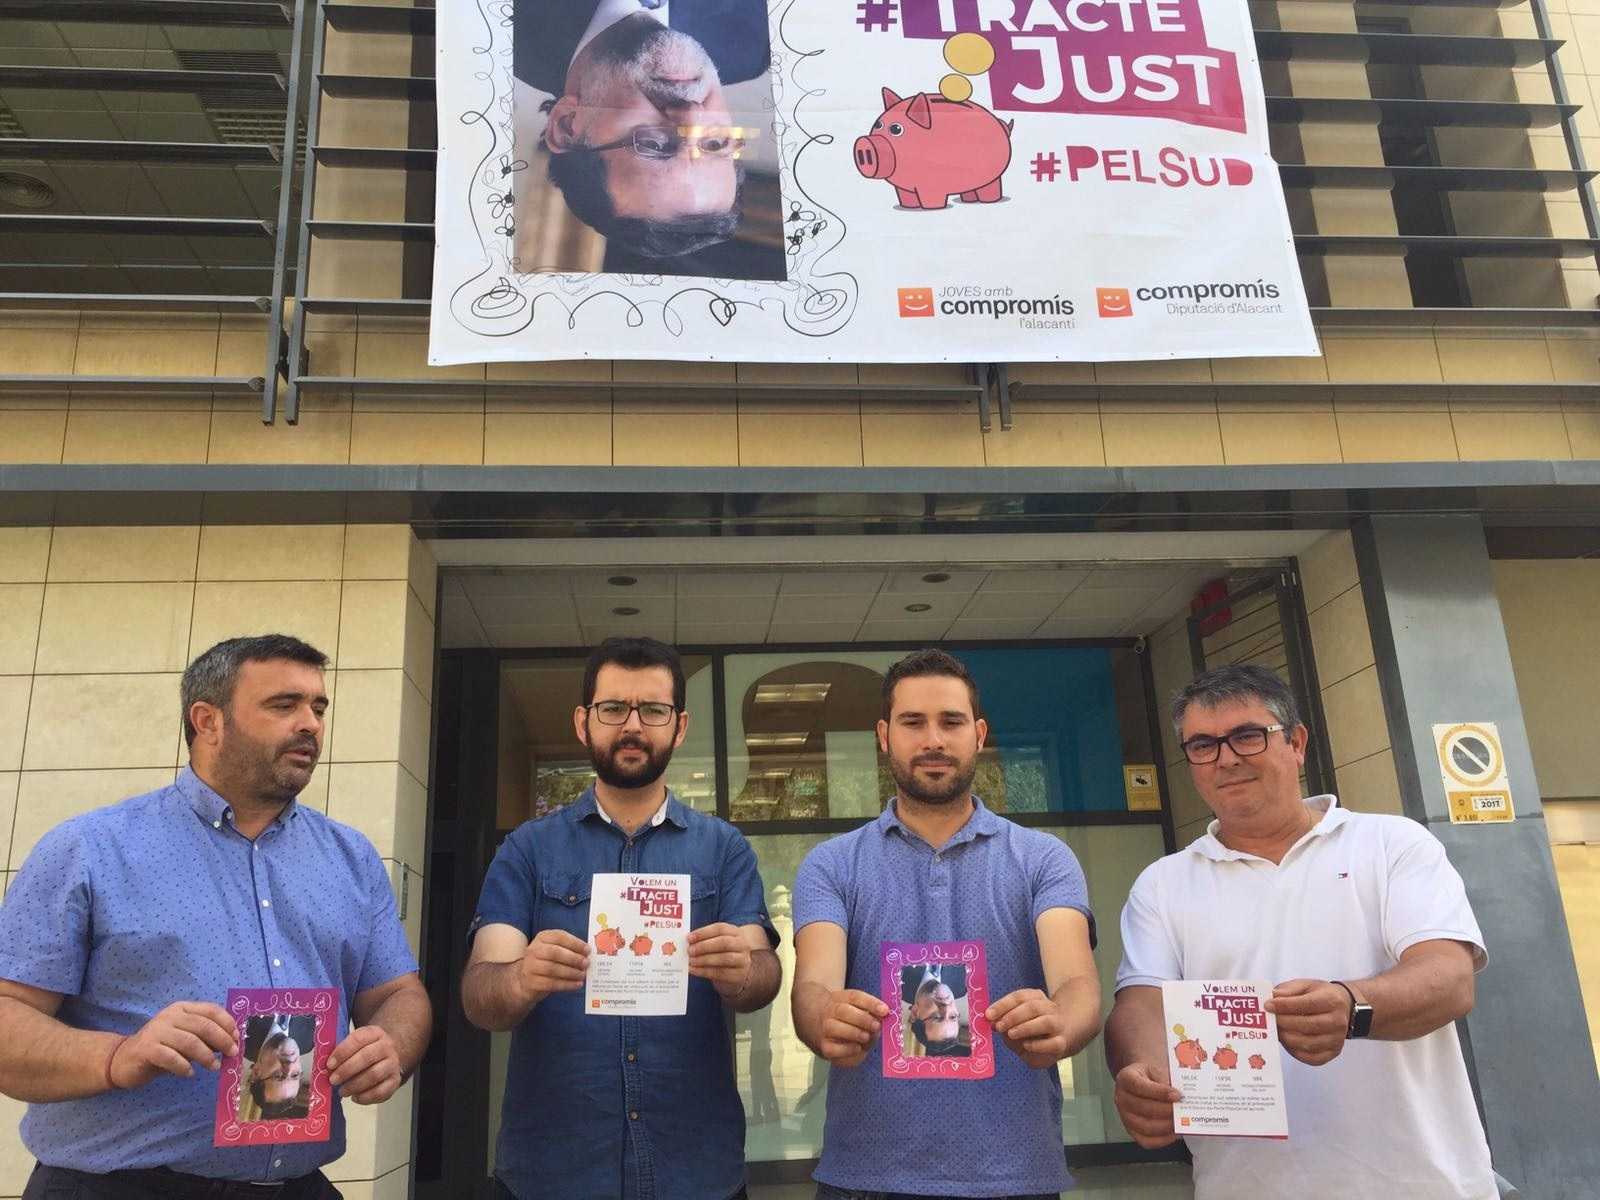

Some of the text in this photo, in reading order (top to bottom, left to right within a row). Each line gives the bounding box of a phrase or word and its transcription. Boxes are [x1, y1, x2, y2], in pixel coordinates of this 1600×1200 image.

[1010, 36, 1220, 106] JUST
[938, 286, 1013, 297] JOVES amb
[1136, 279, 1280, 302] compromís
[940, 295, 1075, 319] compromís
[1166, 303, 1284, 317] Diputació d'Alacant
[643, 900, 680, 915] JUST
[1203, 983, 1255, 993] VOLEM UN
[1222, 1009, 1263, 1025] JUST
